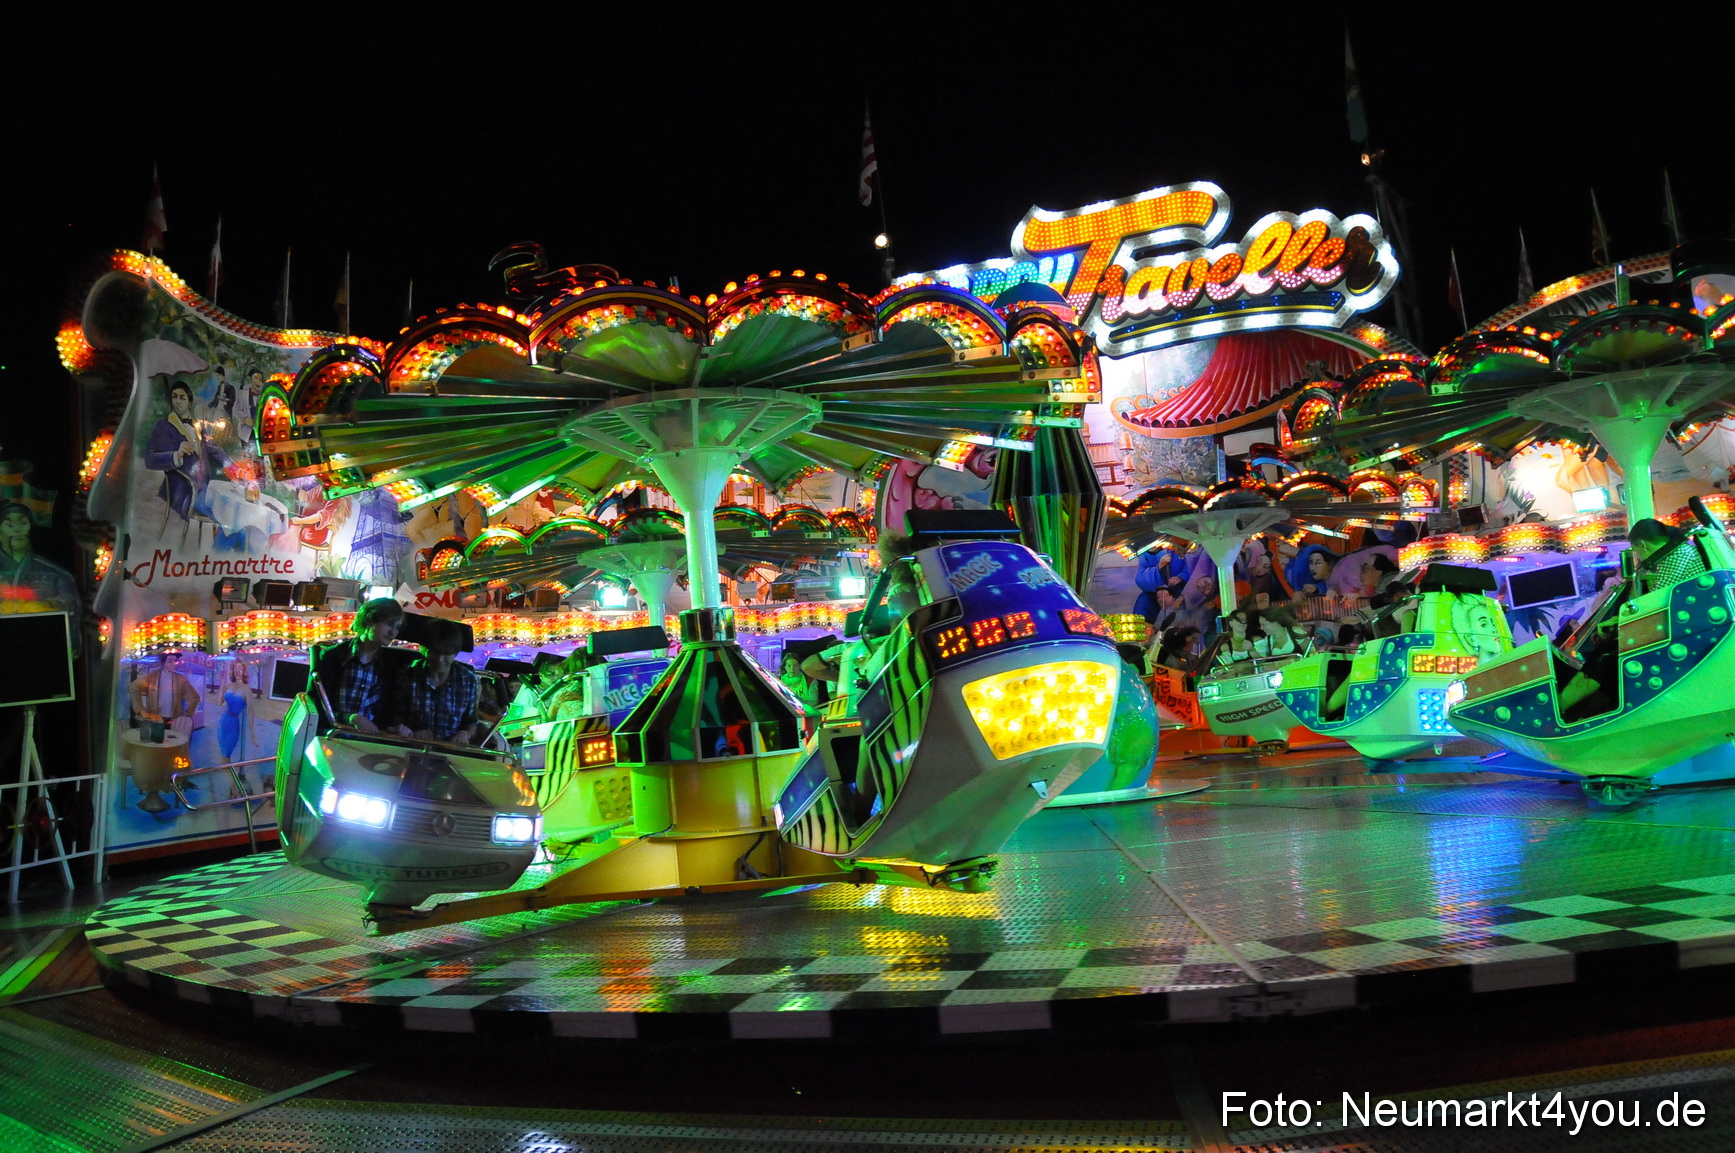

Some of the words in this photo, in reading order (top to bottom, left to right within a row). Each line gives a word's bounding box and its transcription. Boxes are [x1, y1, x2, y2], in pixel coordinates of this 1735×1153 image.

[1022, 189, 1386, 327] Traveller
[132, 549, 295, 588] Montmartre
[949, 553, 1001, 591] MAGIC
[603, 683, 641, 711] NICE
[1220, 711, 1248, 722] HIGH
[1248, 700, 1282, 717] SPEED
[401, 864, 501, 880] TURNER
